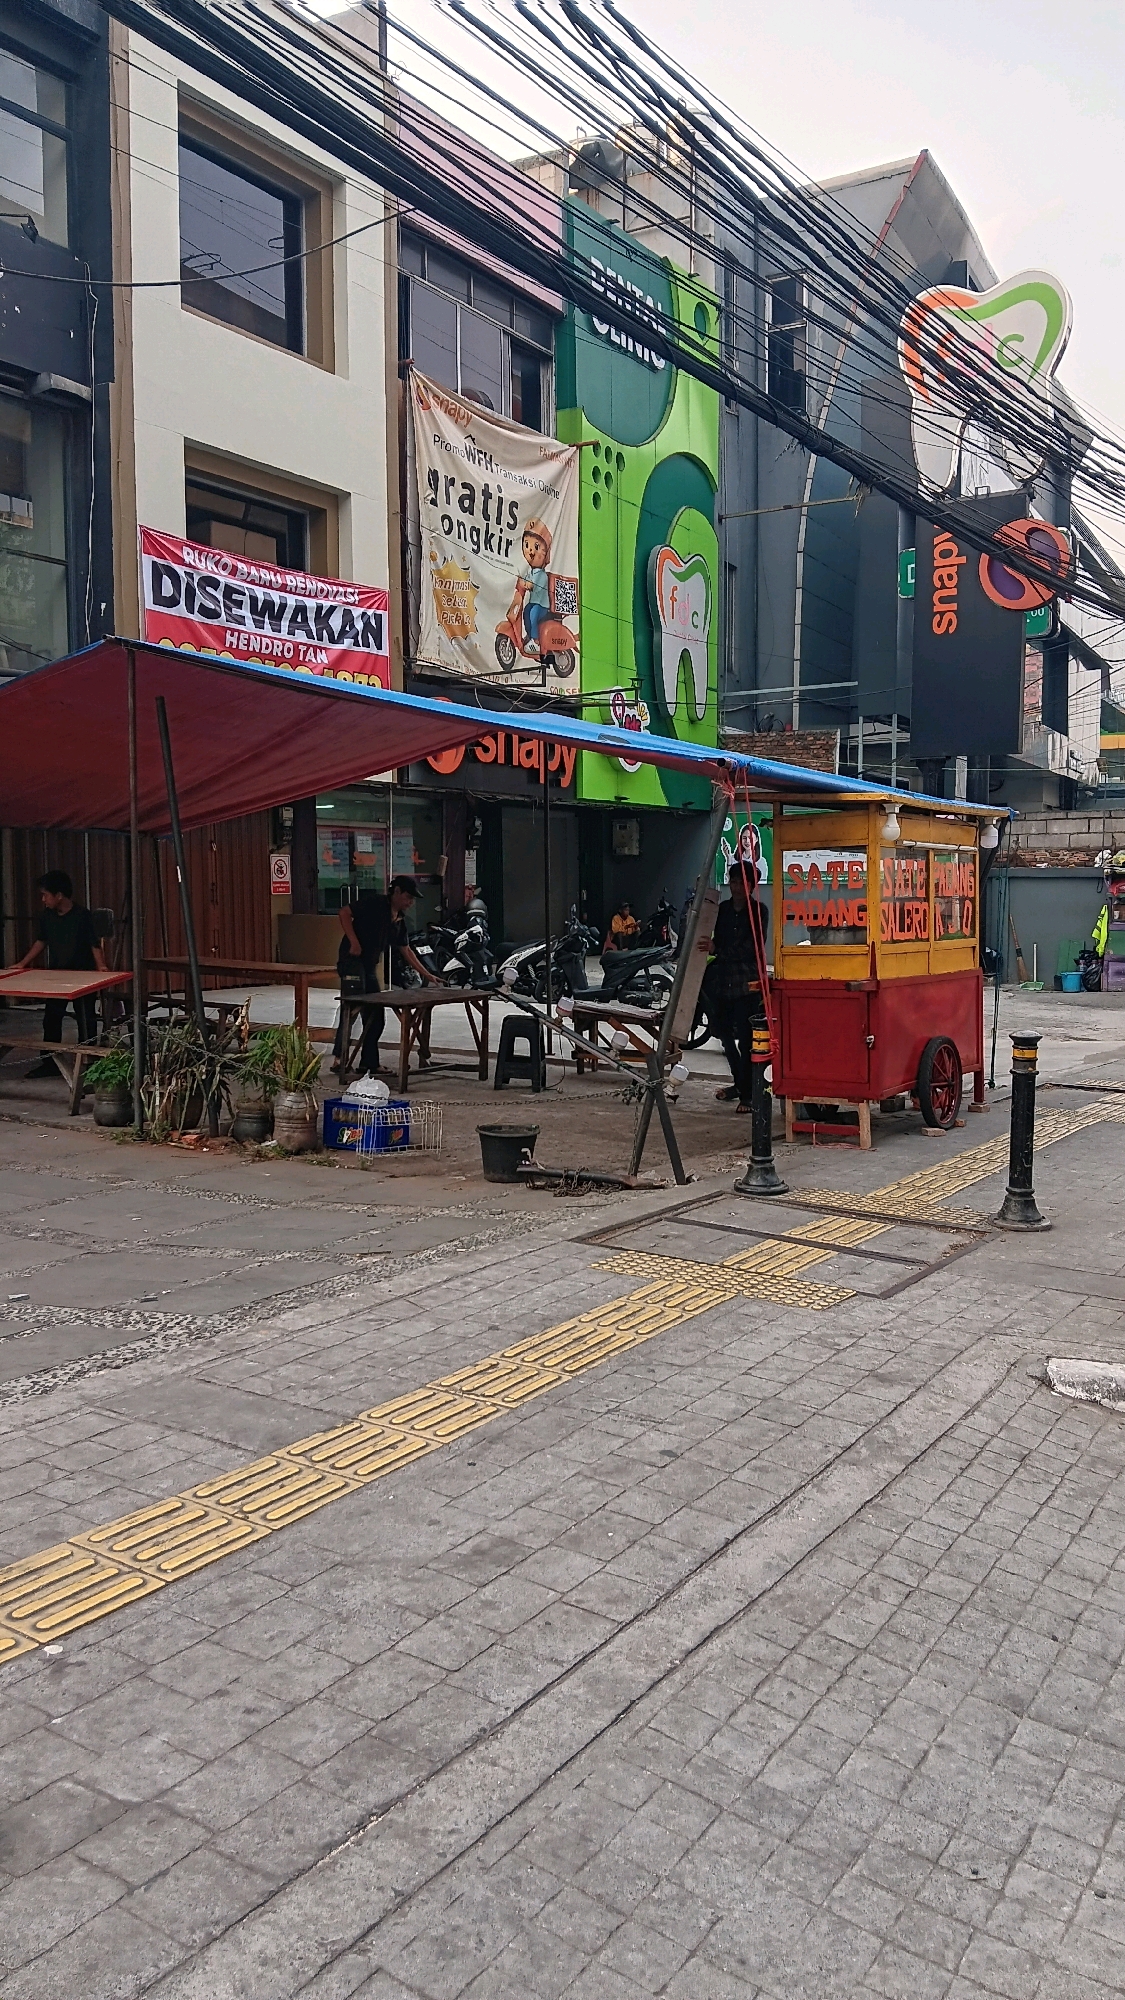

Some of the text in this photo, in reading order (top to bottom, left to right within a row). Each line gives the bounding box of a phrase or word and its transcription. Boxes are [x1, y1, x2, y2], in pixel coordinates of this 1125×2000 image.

[431, 394, 473, 428] snapy
[433, 434, 466, 458] Promo
[464, 441, 494, 474] WFH
[494, 463, 537, 489] Transaksi
[440, 513, 513, 558] ongkir
[182, 545, 360, 604] RUKO BARU RENOVASI
[151, 559, 383, 651] DISEWAKAN
[669, 585, 699, 630] fdc
[225, 630, 294, 660] HENDRO
[297, 644, 330, 665] TAN
[551, 636, 568, 647] snapy
[475, 731, 577, 788] snapy
[787, 860, 864, 894] SATE
[882, 857, 975, 898] SATE PADANG
[782, 897, 867, 928] PADANG
[880, 900, 930, 942] SALERO
